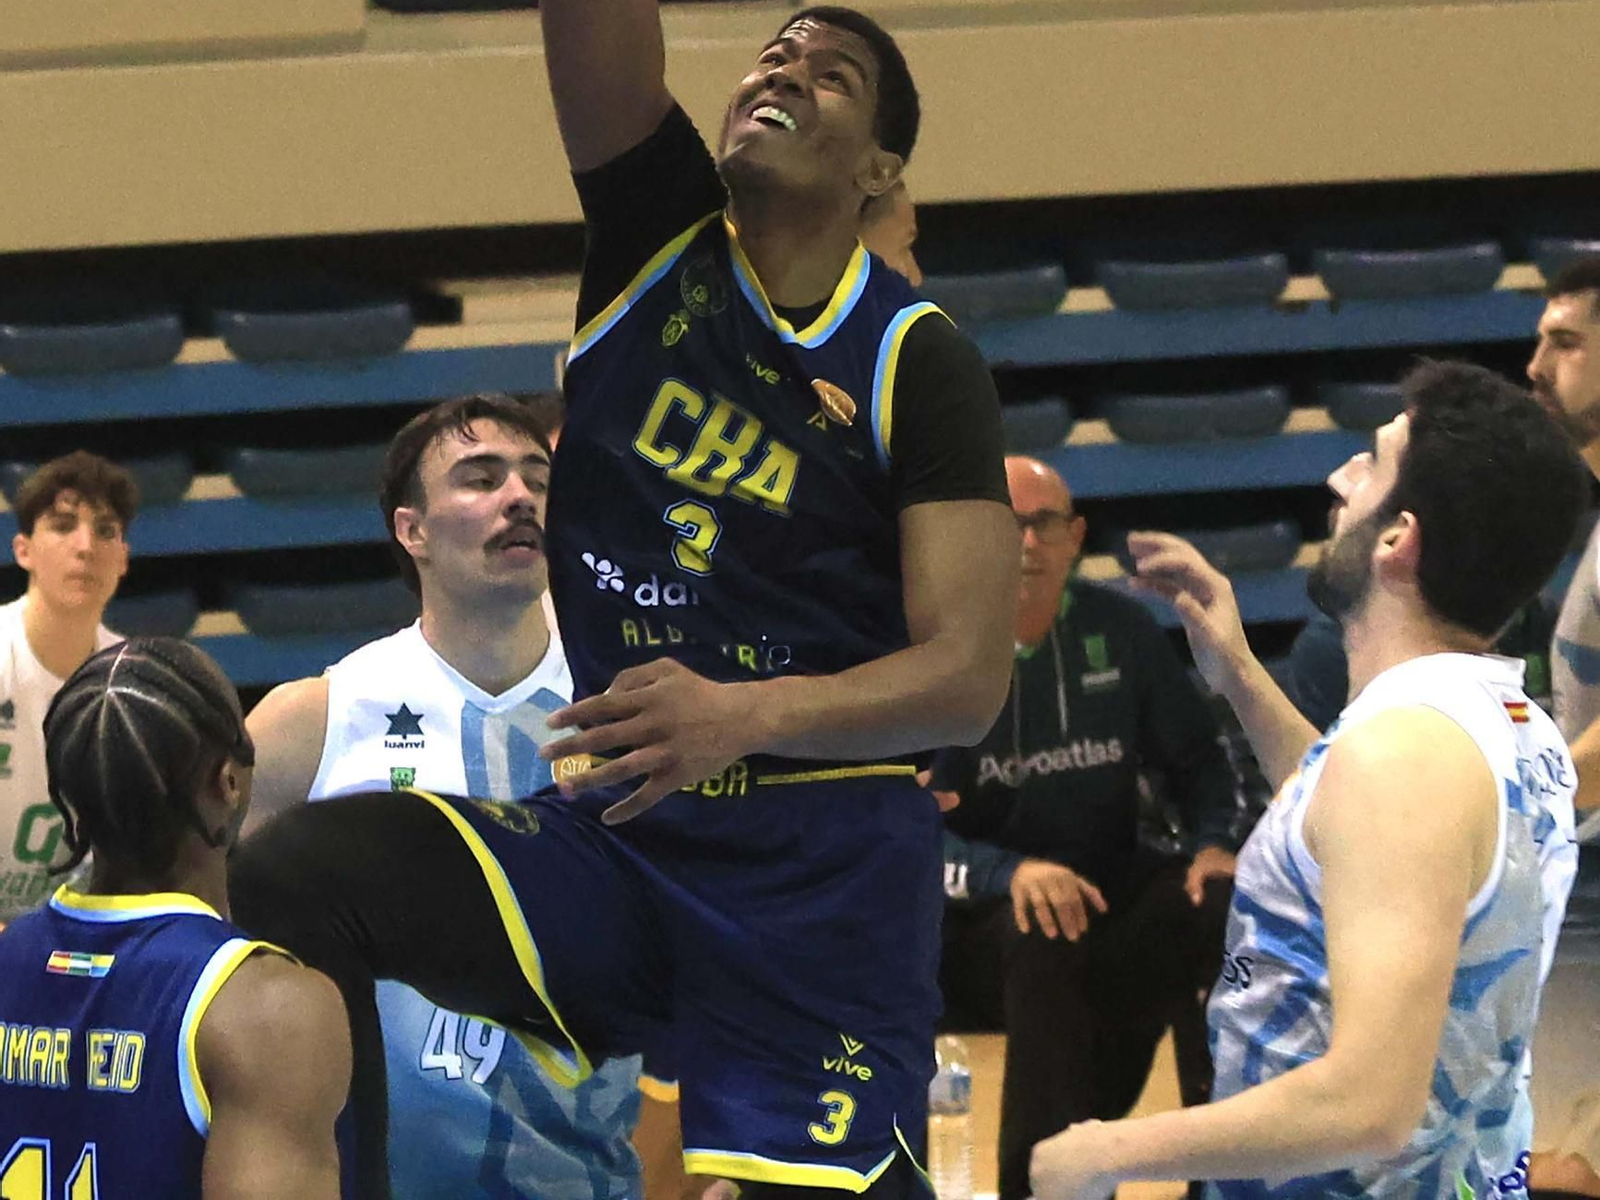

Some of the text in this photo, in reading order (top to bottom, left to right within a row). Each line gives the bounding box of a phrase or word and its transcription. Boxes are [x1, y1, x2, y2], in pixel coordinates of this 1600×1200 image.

[632, 376, 800, 518] CBA
[663, 499, 724, 576] 3
[384, 739, 425, 750] luanvi
[0, 1022, 146, 1093] MAR EID
[420, 1007, 507, 1085] 49
[822, 1056, 873, 1081] vive
[808, 1089, 857, 1146] 3
